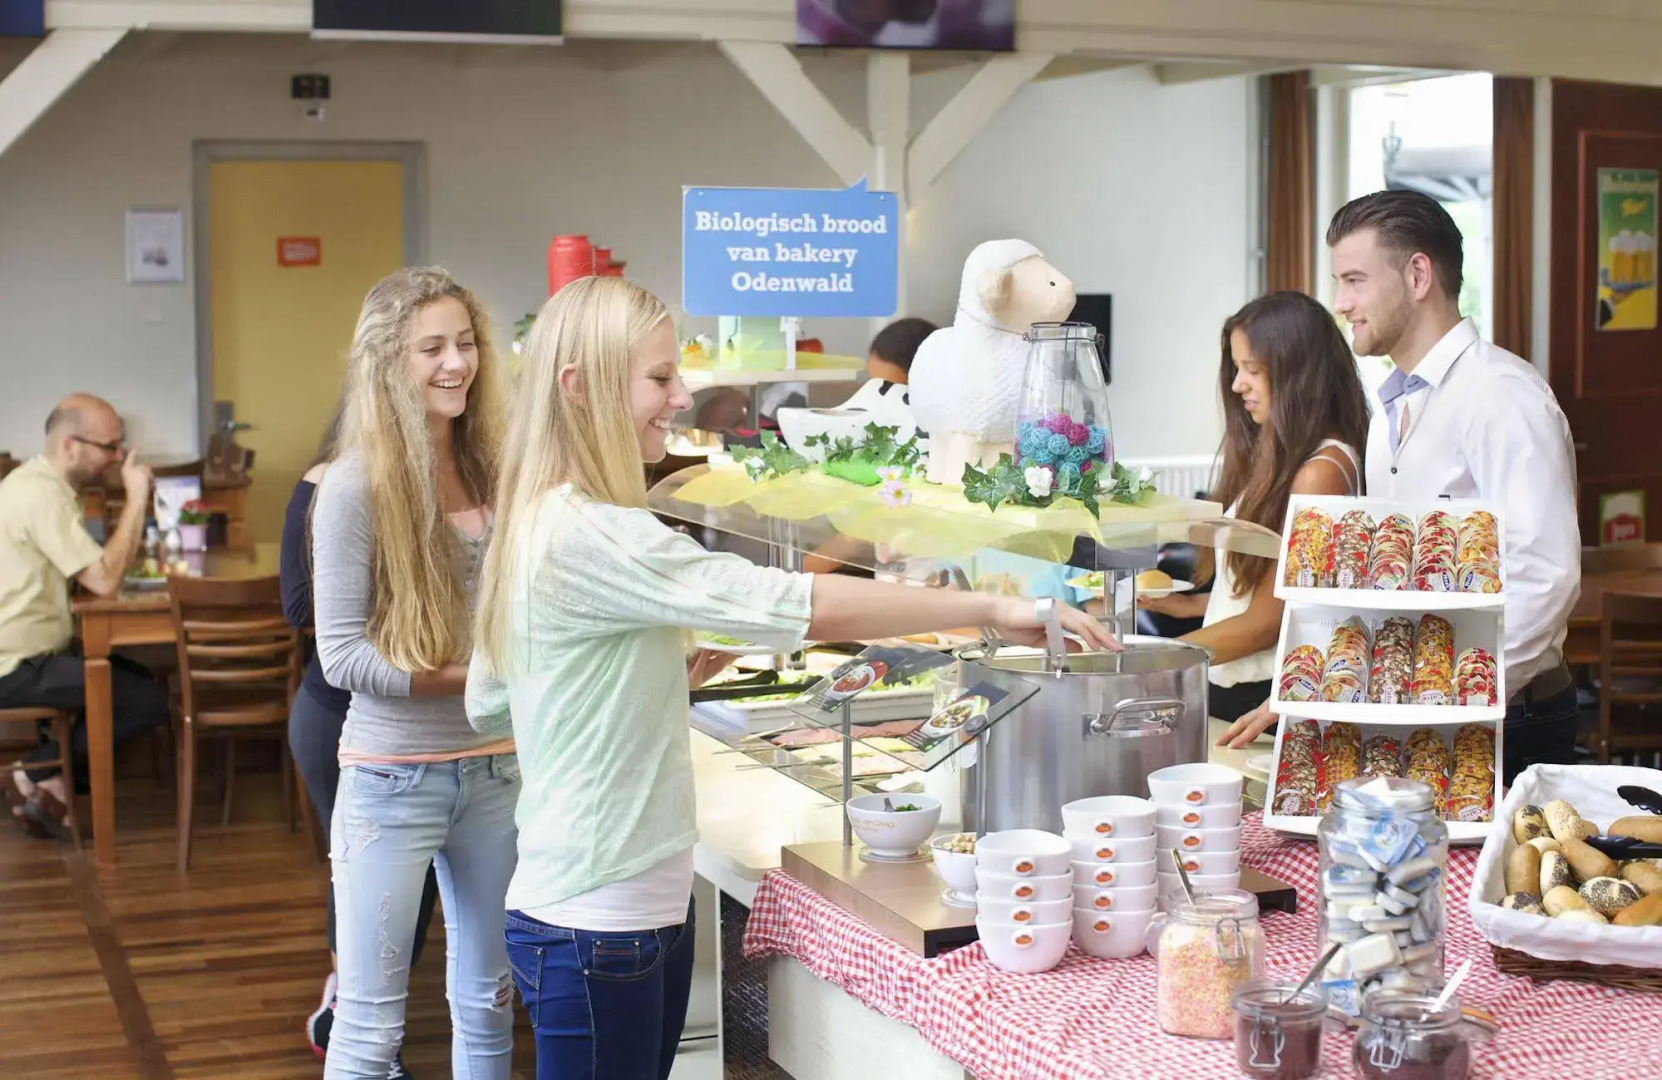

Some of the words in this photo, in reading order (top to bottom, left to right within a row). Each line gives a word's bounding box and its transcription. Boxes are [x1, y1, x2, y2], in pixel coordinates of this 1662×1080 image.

[695, 211, 817, 237] Biologisch
[822, 213, 887, 233] brood
[727, 246, 770, 262] van
[775, 243, 858, 268] bakery
[731, 271, 853, 292] Odenwald
